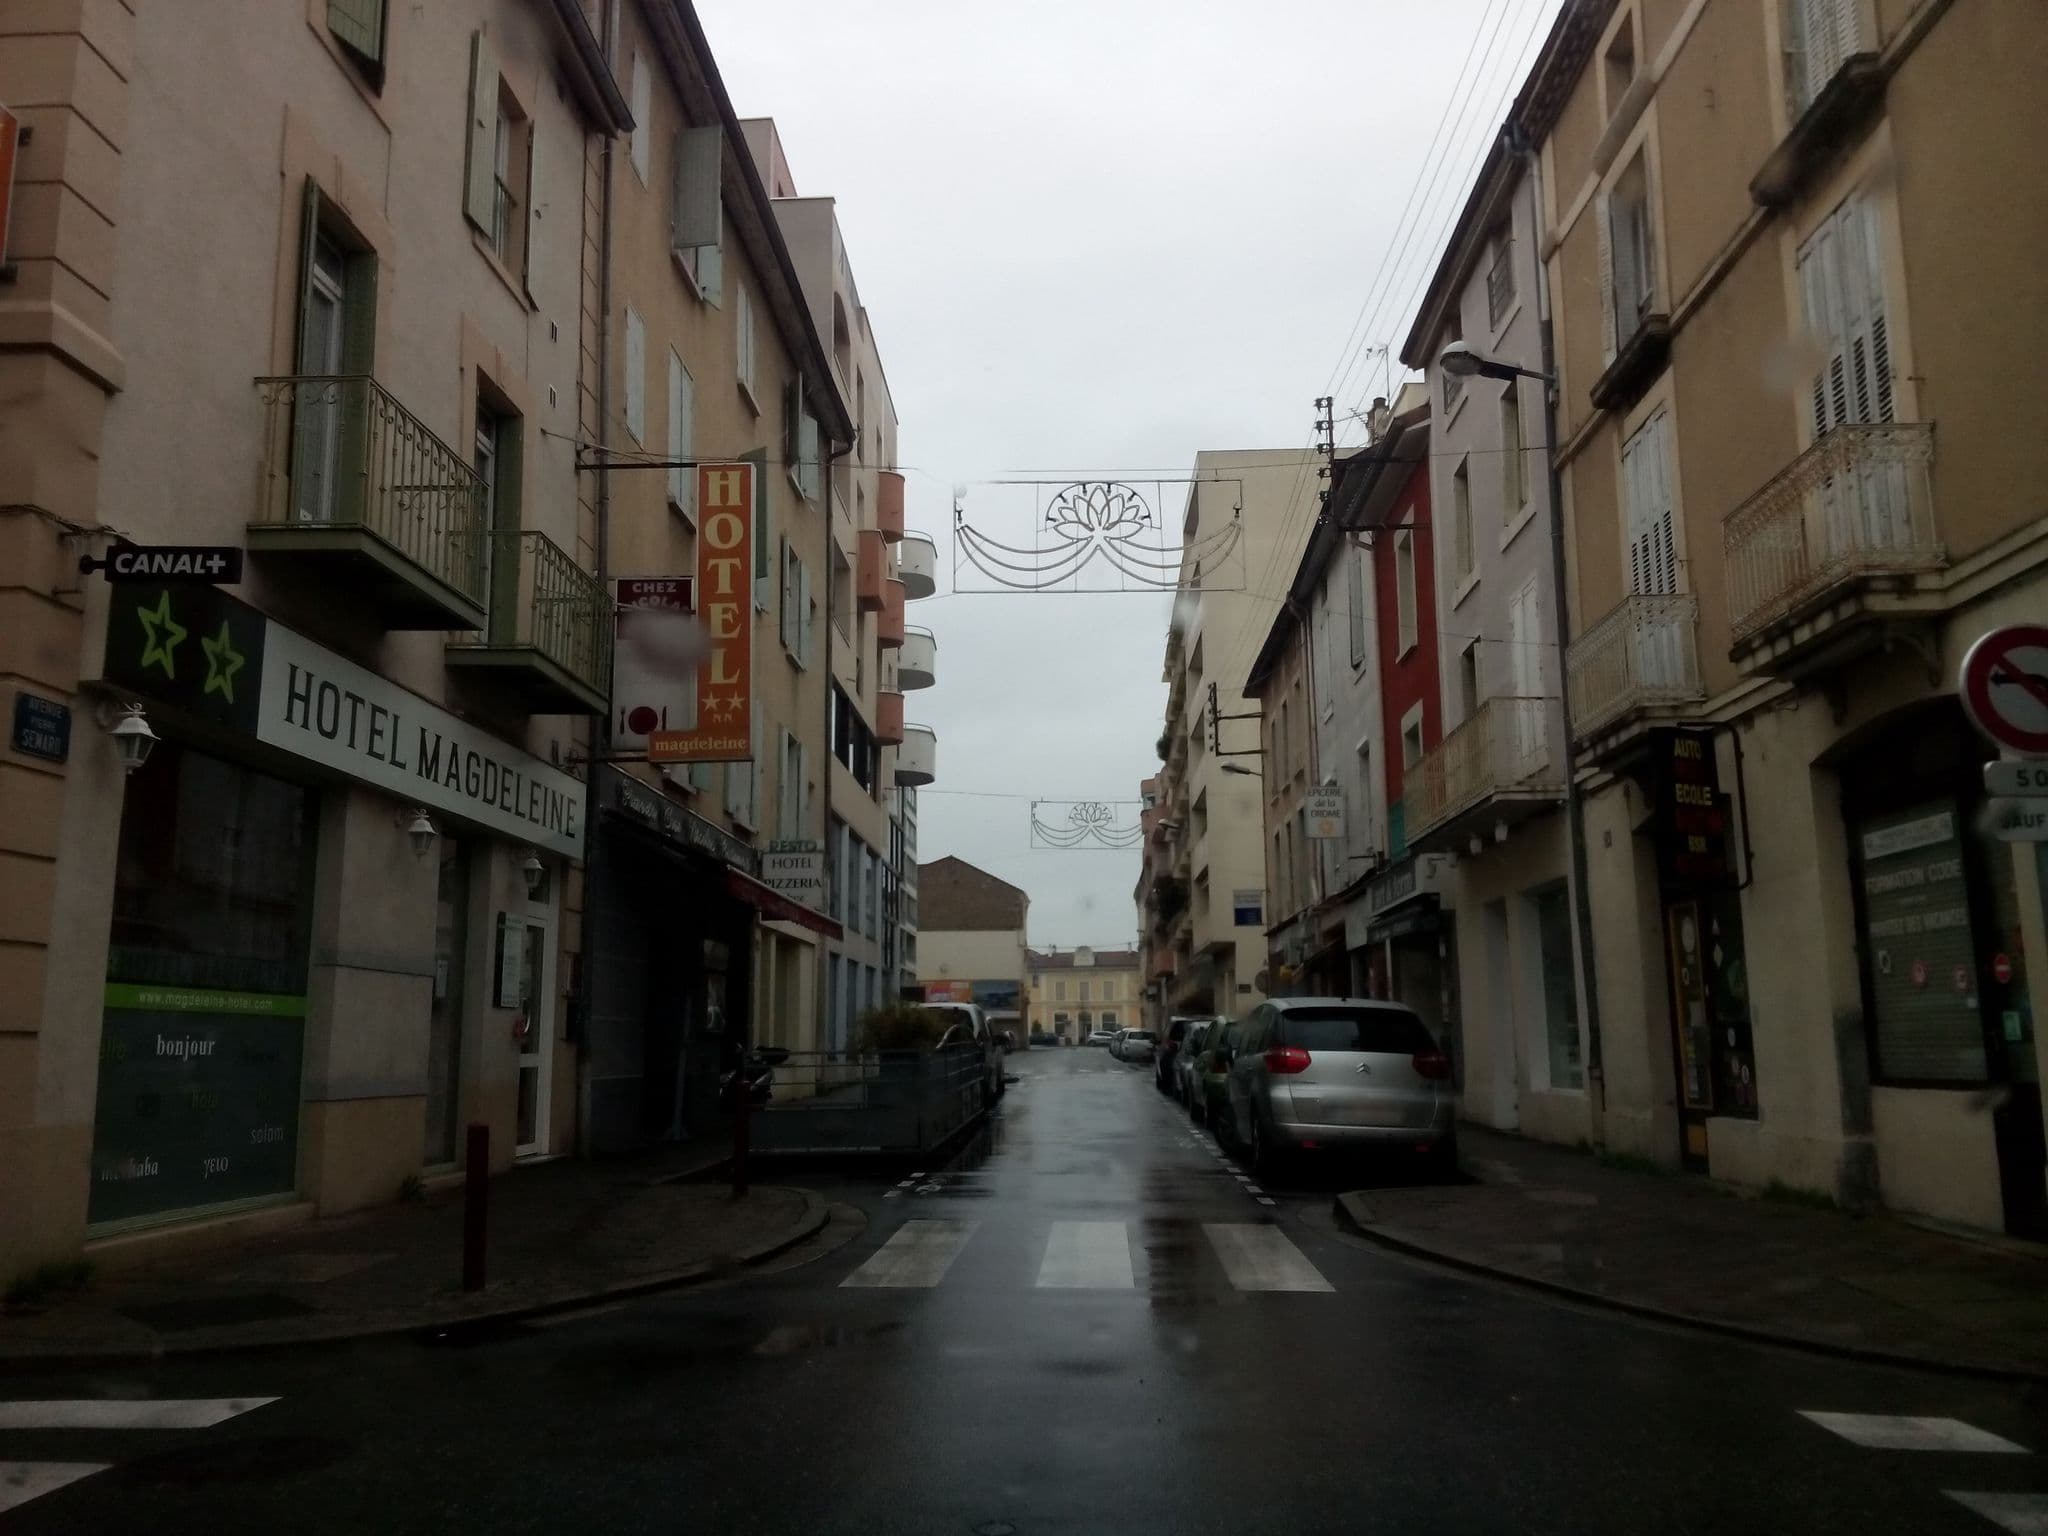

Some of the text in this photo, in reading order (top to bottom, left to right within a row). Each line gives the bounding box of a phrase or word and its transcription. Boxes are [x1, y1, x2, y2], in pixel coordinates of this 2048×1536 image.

[114, 551, 227, 576] CANAL+
[631, 581, 678, 593] CHEZ
[704, 469, 745, 686] HOTEL
[284, 662, 407, 770] HOTEL
[417, 726, 577, 839] MAGDELEINE
[655, 736, 746, 753] magdeleine
[1673, 737, 1702, 760] AUTO
[1674, 783, 1713, 806] ECOLE
[772, 856, 814, 870] HOTEL
[1927, 859, 1963, 882] CODE
[764, 878, 823, 889] PIZZERIA
[155, 1033, 216, 1062] bonjour
